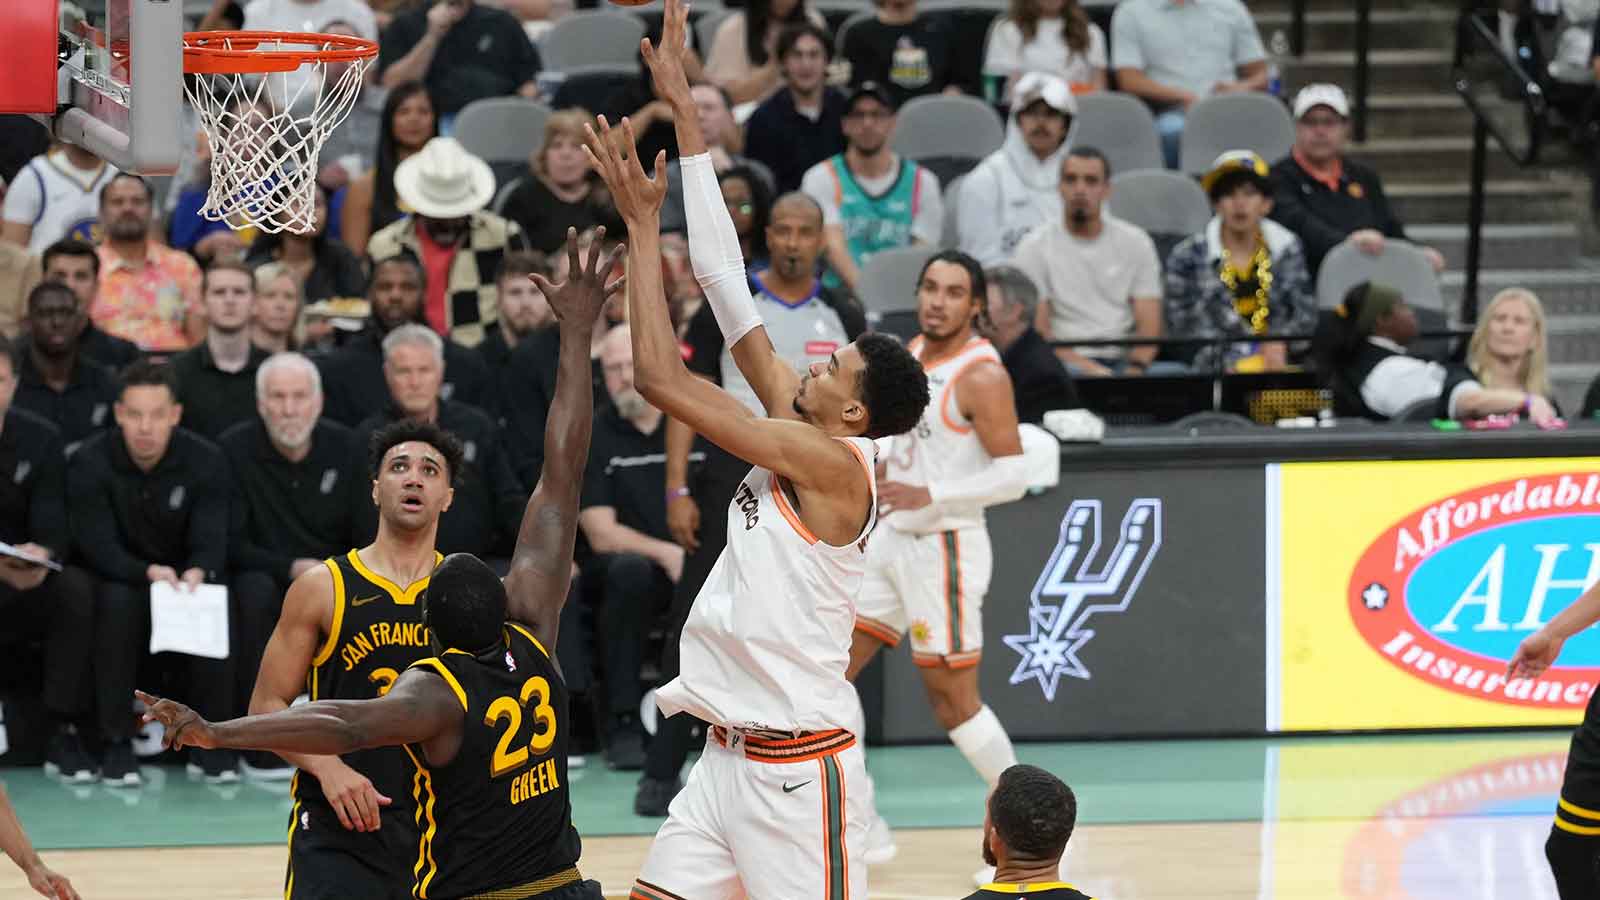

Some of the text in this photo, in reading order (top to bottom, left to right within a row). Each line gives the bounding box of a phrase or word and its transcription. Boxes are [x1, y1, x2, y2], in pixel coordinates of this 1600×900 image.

[1394, 474, 1600, 572] Affordabl
[341, 631, 375, 671] SAN
[1382, 630, 1599, 704] Insuranc
[484, 675, 557, 778] 23
[511, 757, 560, 805] GREEN
